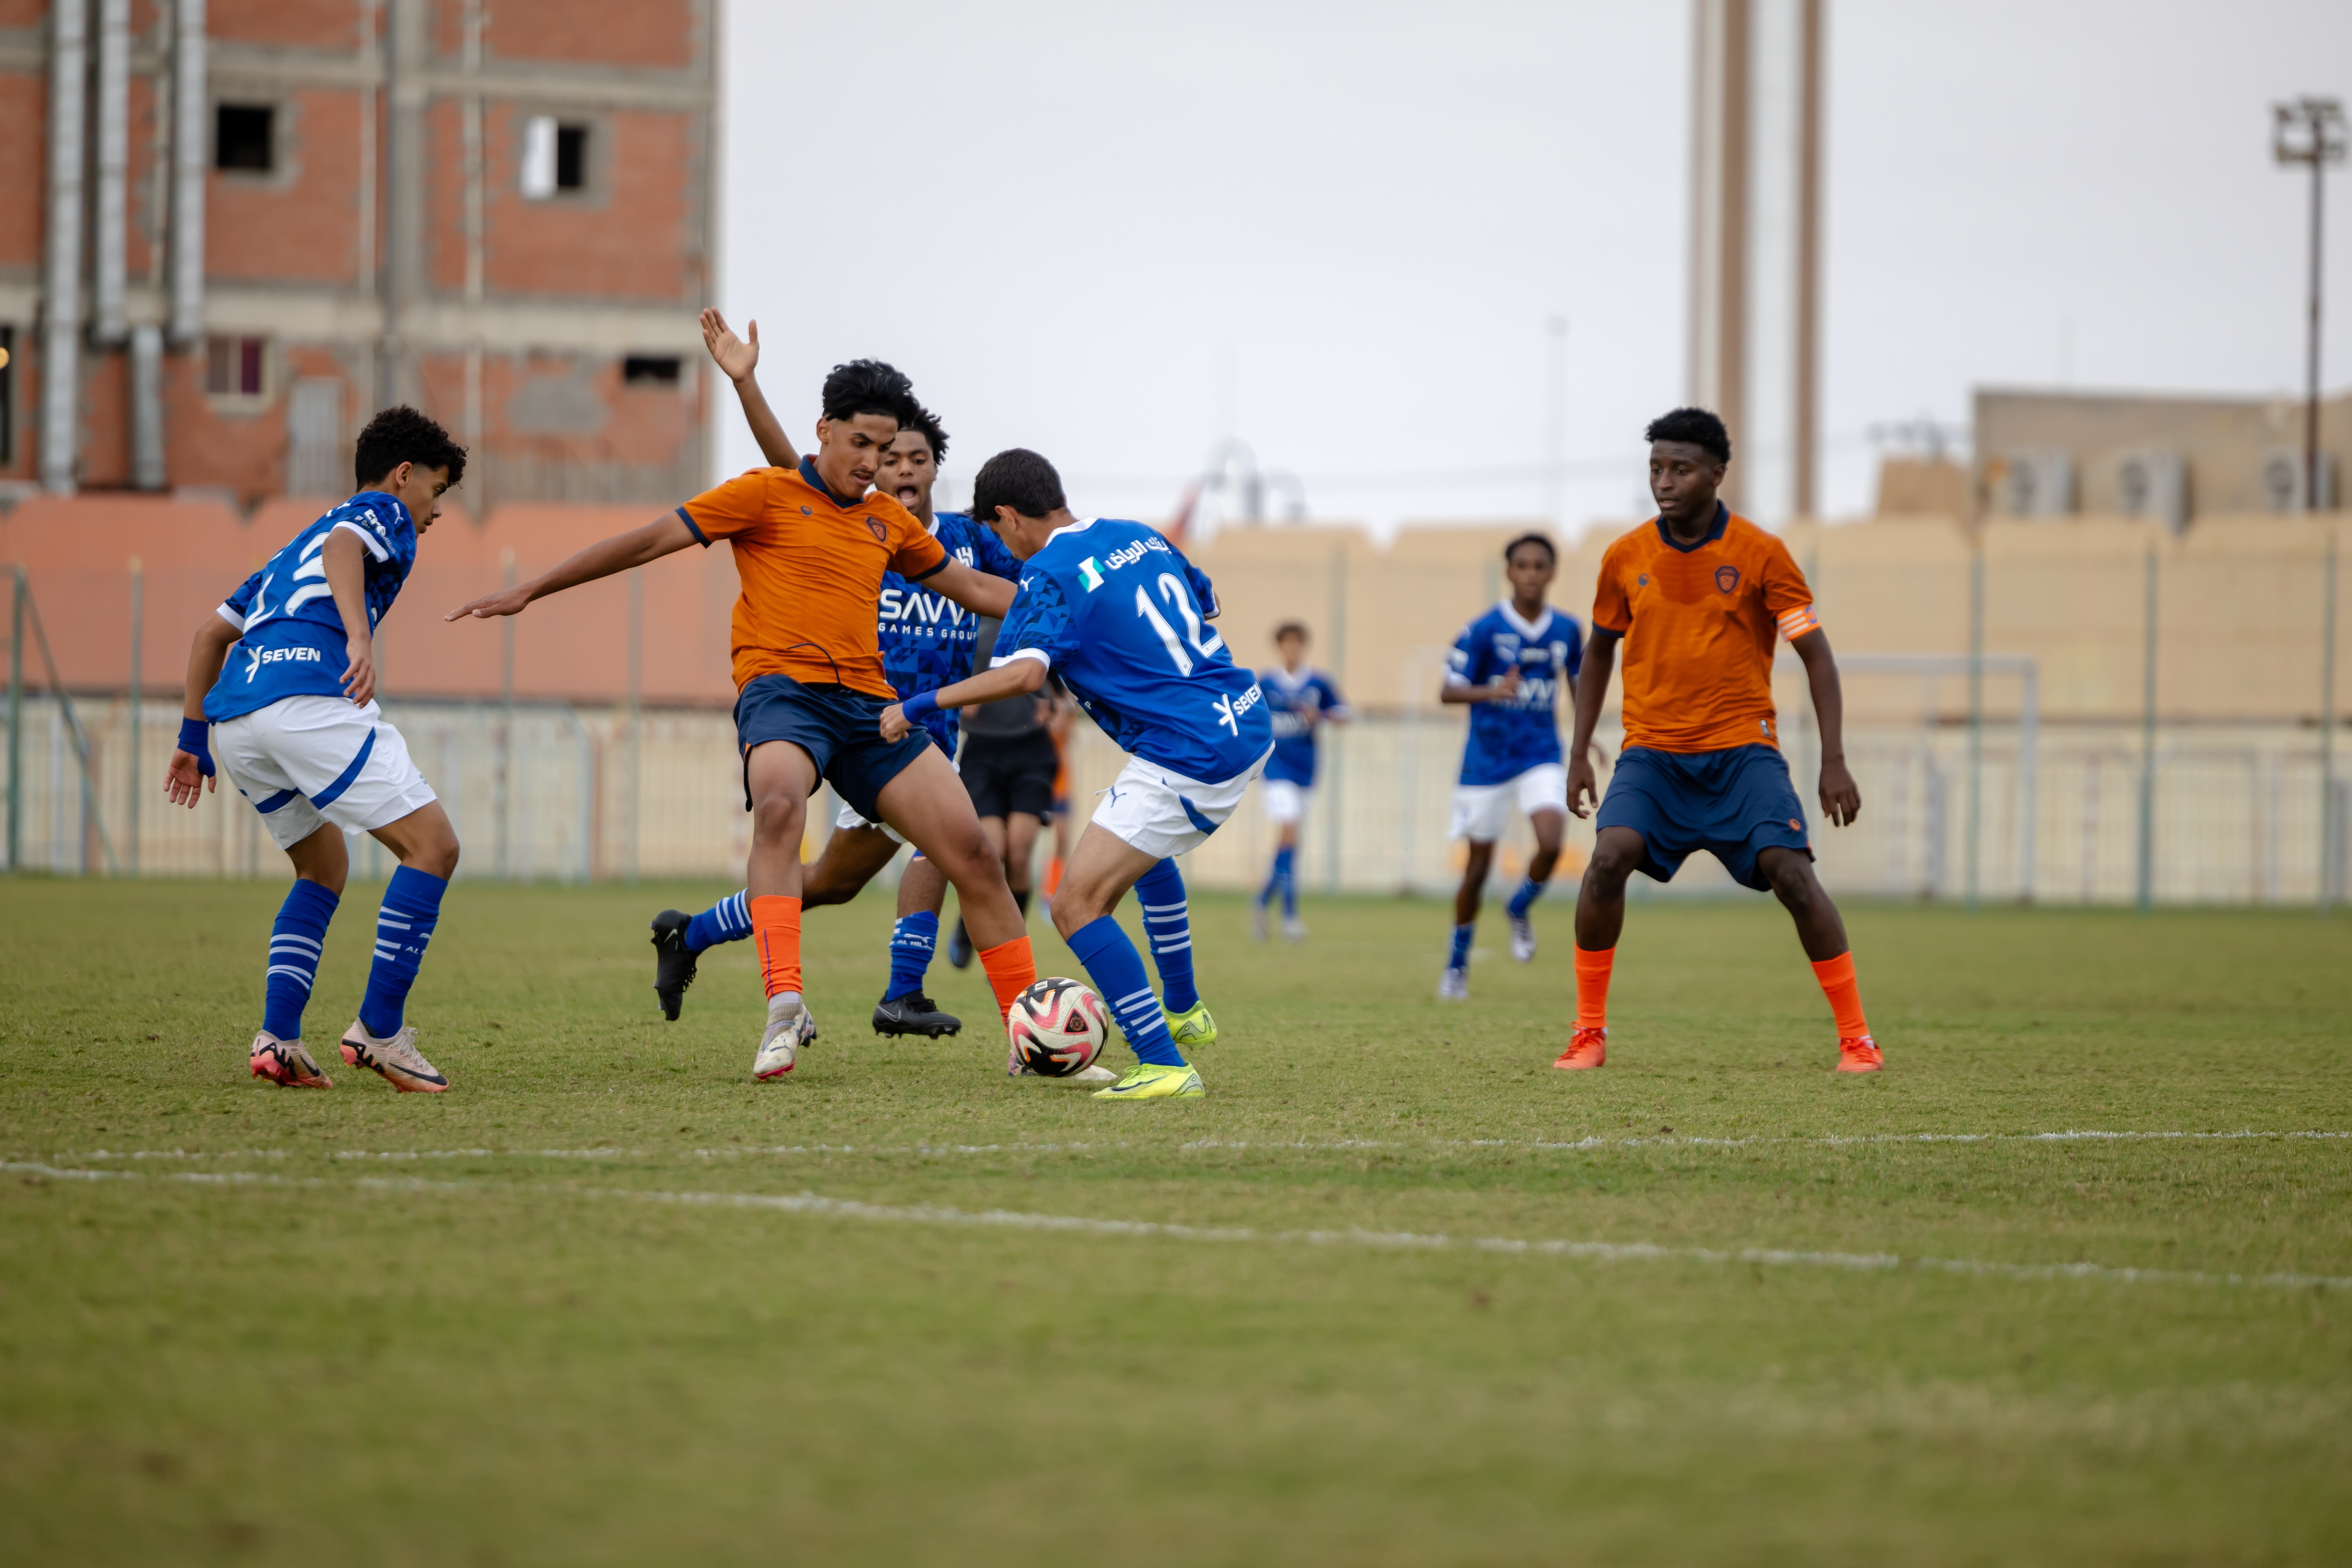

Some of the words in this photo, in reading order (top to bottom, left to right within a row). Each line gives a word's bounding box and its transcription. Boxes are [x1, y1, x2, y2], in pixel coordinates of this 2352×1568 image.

[1105, 539, 1148, 569] الرياض
[878, 622, 934, 637] GAMES
[1136, 572, 1223, 677] 12
[262, 647, 321, 664] SEVEN
[1233, 681, 1262, 715] SEVEN
